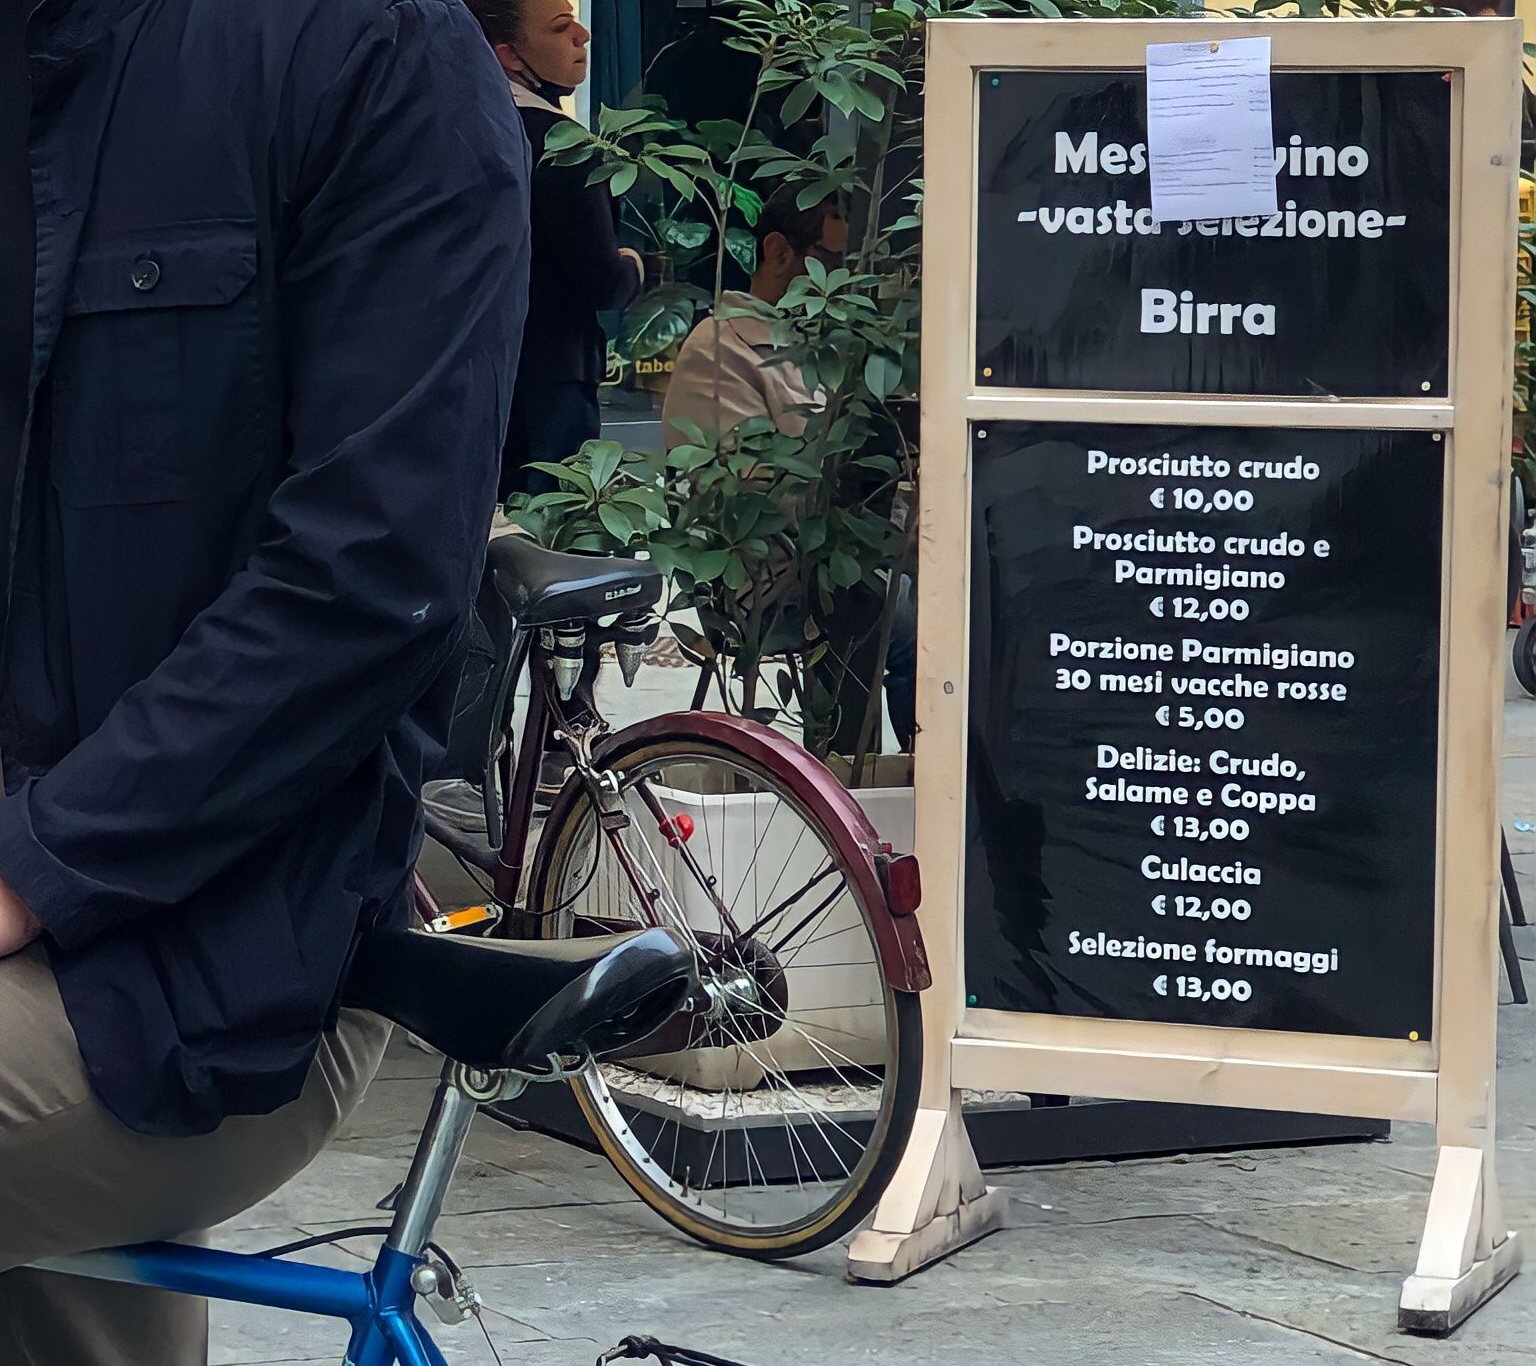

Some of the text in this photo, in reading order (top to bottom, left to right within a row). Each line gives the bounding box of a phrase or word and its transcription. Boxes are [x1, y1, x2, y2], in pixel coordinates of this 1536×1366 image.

[1017, 199, 1162, 235] -vasta
[1140, 288, 1276, 336] Birra
[1087, 450, 1320, 481] Prosciutto crudo
[1149, 487, 1254, 514] € 10,00
[1073, 525, 1331, 558] Prosciutto crudo e
[1115, 559, 1286, 591] Parmigiano
[1149, 596, 1250, 623] € 12,00
[1049, 632, 1355, 670] Porzione Parmigiano
[1055, 668, 1347, 702] 30 mesi vacche rosse
[1154, 705, 1245, 731] € 5,00
[1097, 744, 1306, 782] Delizie: Crudo,
[1085, 776, 1316, 815] Salame e Coppa
[1150, 815, 1250, 842] € 13,00
[1140, 854, 1261, 885] Culaccia
[1151, 894, 1252, 922] € 12,00
[1068, 930, 1338, 974] Selezione formaggi
[1152, 974, 1252, 1002] € 13,00
